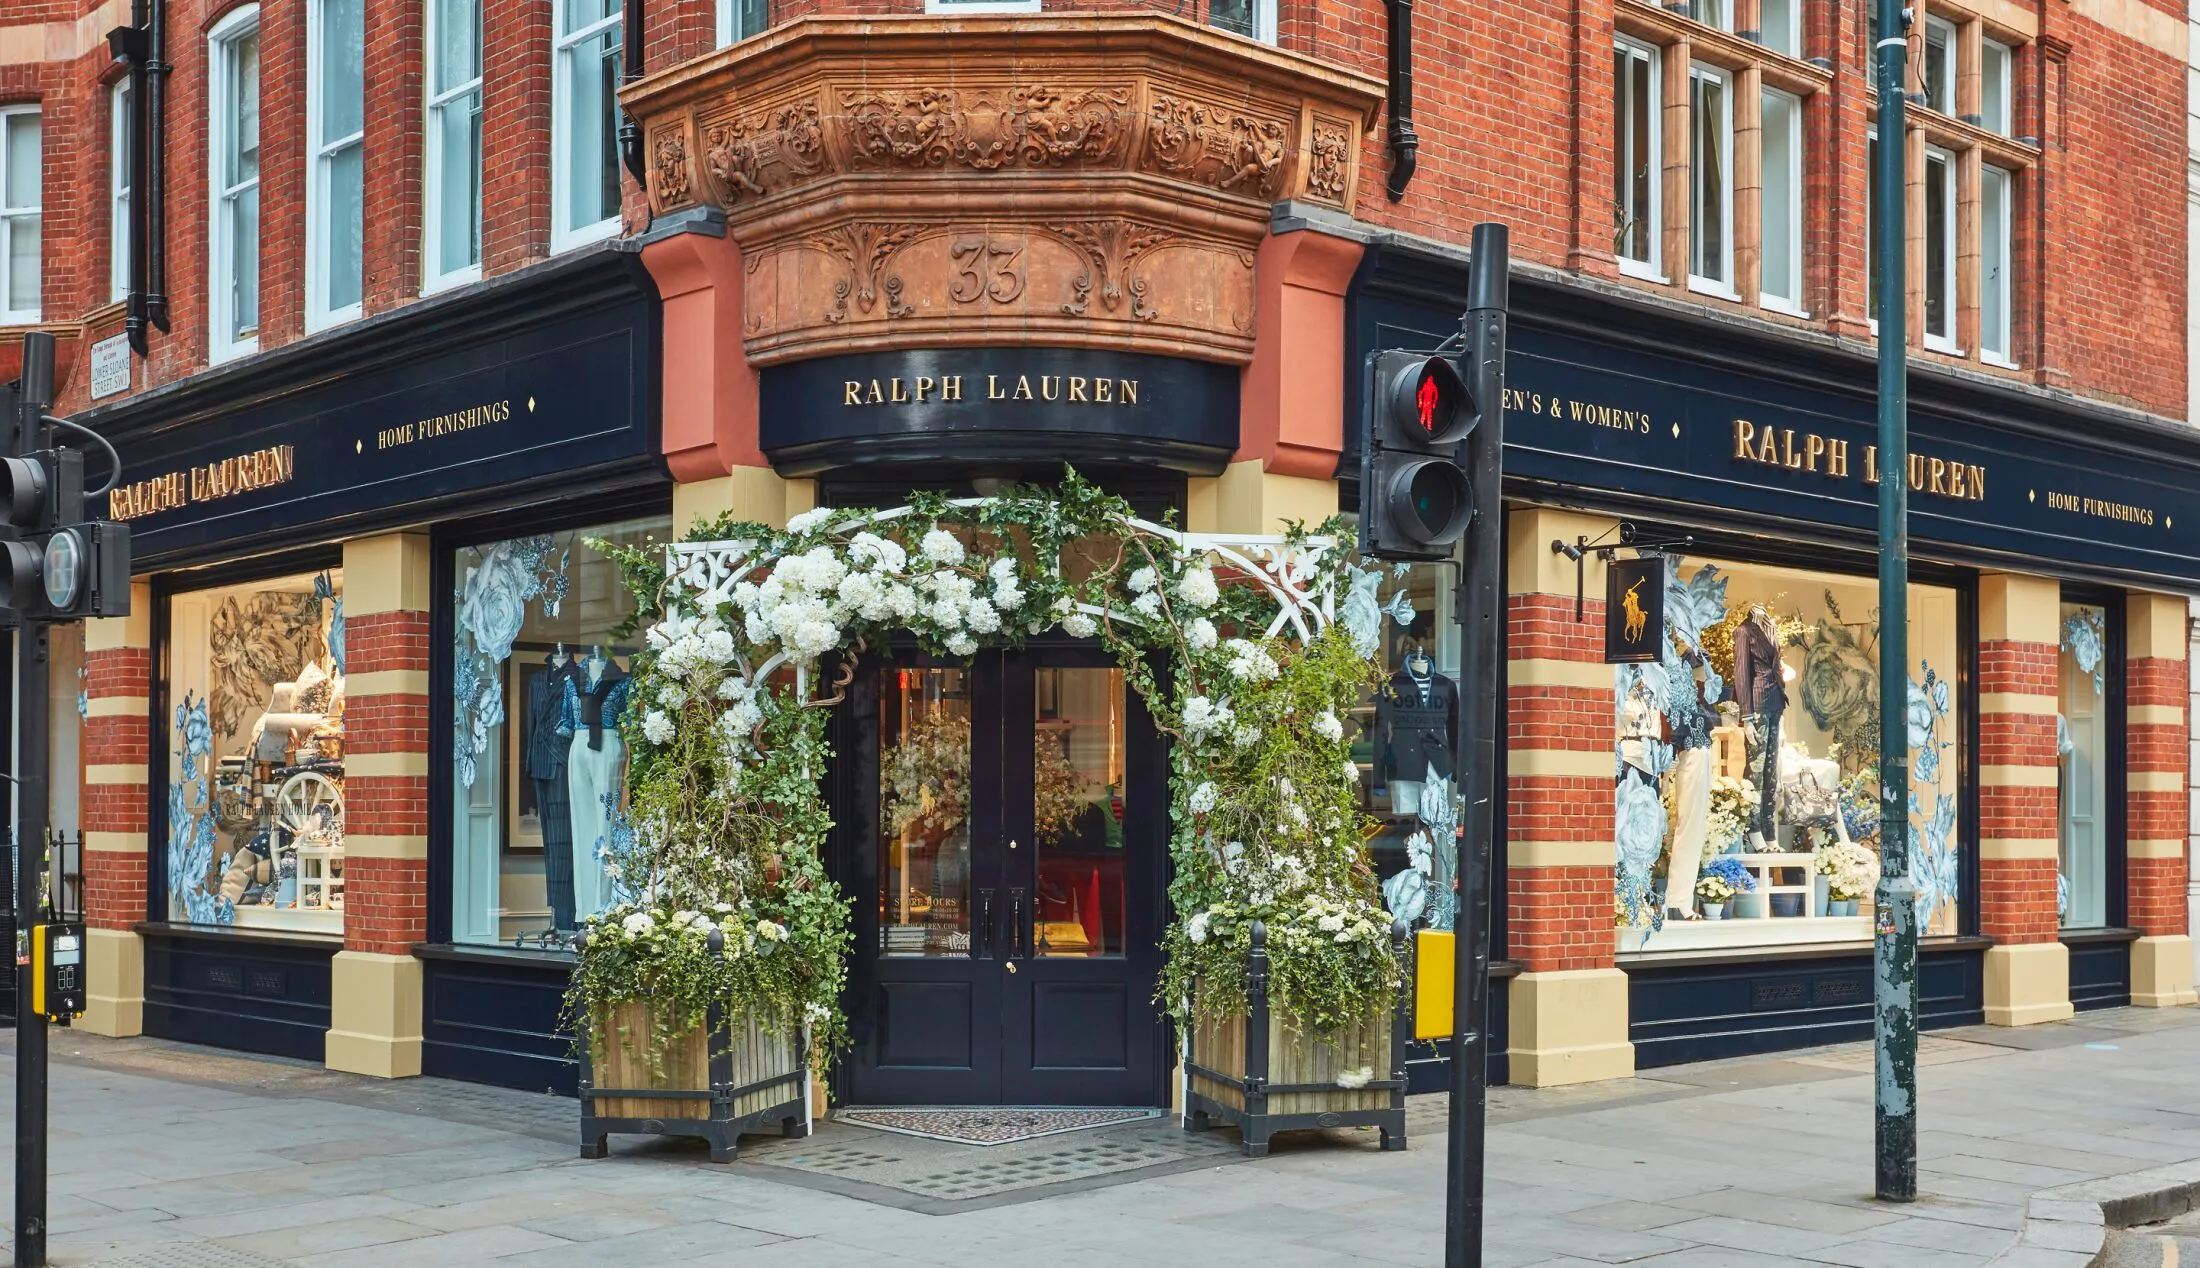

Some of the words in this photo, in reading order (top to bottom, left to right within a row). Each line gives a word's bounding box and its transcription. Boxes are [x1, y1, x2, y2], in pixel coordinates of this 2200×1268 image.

[949, 240, 1025, 304] 33
[92, 363, 109, 381] LOWER
[109, 356, 129, 375] SLOANE
[844, 375, 962, 405] RALPH
[987, 375, 1138, 405] LAUREN
[378, 423, 414, 450] HOME
[418, 400, 510, 440] FURNISHINGS
[1502, 388, 1542, 415] EN'S
[1550, 397, 1562, 419] &
[1569, 400, 1650, 434] WOMEN'S
[109, 472, 187, 521] RALPH
[190, 445, 293, 502] LAUREN
[1732, 419, 1849, 477] RALPH
[1864, 445, 1986, 501] LUREN
[2048, 491, 2080, 513] HOME
[2083, 497, 2154, 526] FURNISHINGS
[894, 897, 923, 907] SORE
